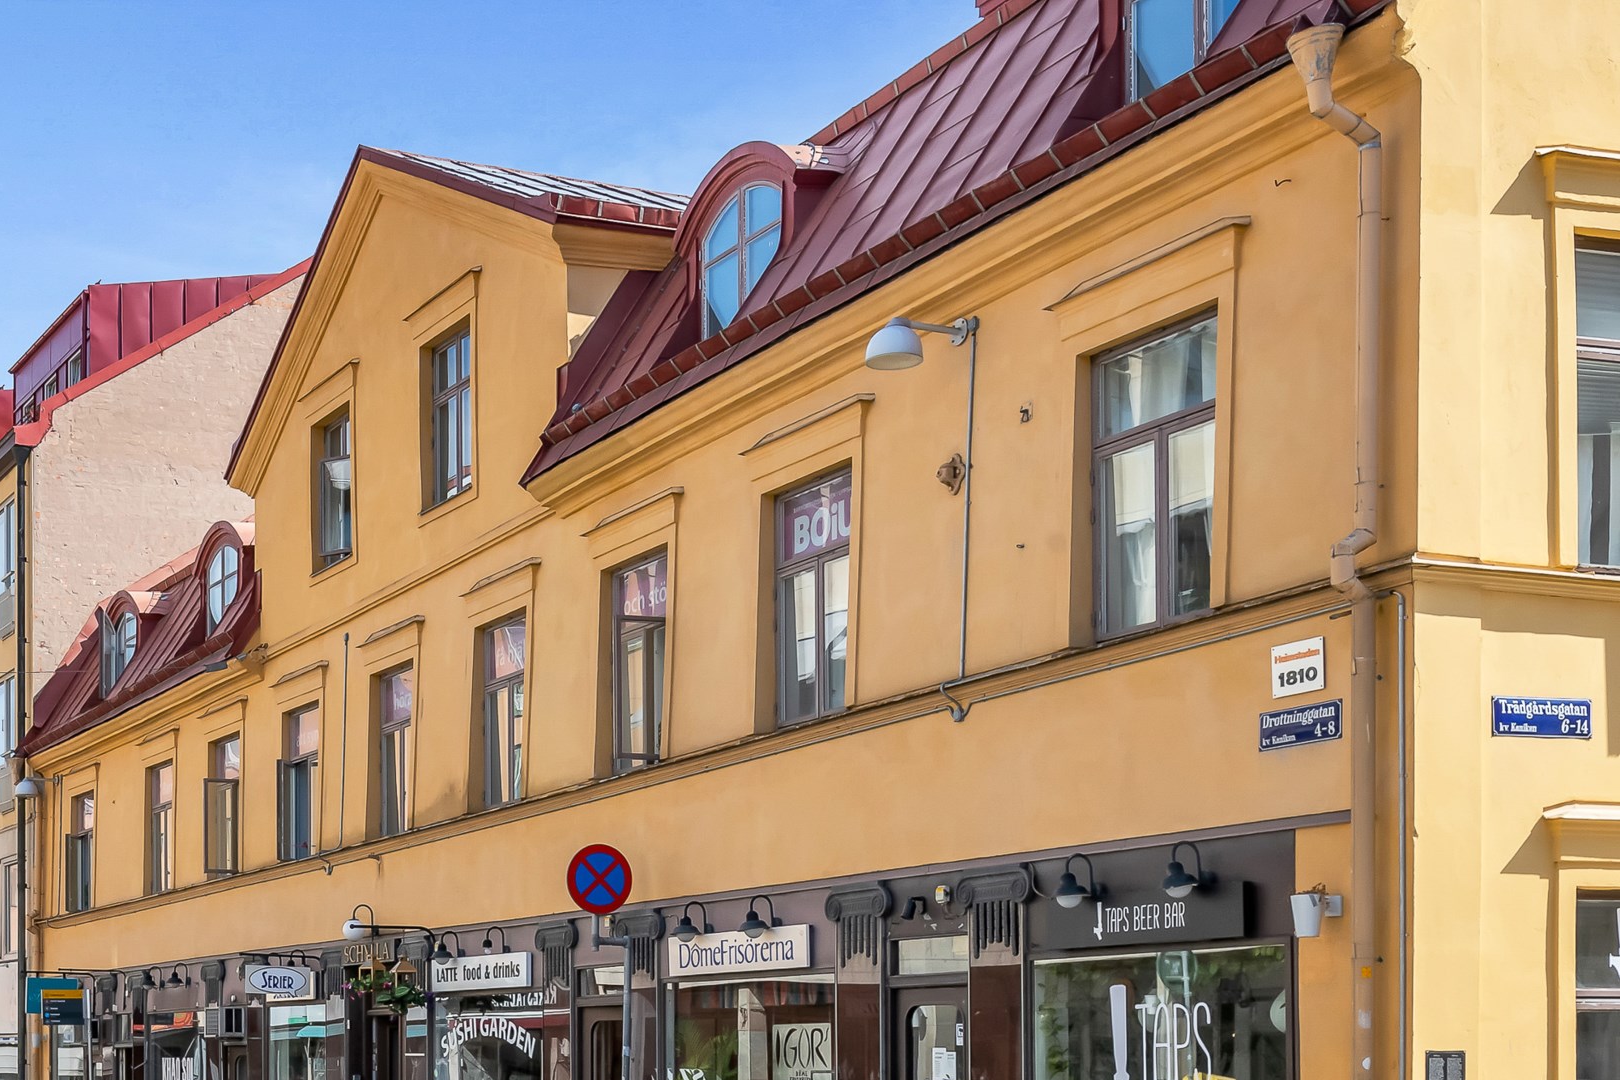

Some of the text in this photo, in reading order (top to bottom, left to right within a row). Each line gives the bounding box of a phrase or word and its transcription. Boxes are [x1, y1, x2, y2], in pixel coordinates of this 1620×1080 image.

[1278, 666, 1318, 687] 1810
[1262, 706, 1336, 729] Drottninggatan
[1499, 699, 1588, 720] Trädgårdsgatan
[1314, 721, 1336, 737] 4-8
[1561, 719, 1589, 734] 6-14
[1105, 901, 1186, 933] TAPS BEER BAR
[679, 938, 795, 969] DômeFrisörerna
[436, 961, 521, 983] LATTE food & drinks
[440, 1016, 536, 1059] SUSHI GARDEN
